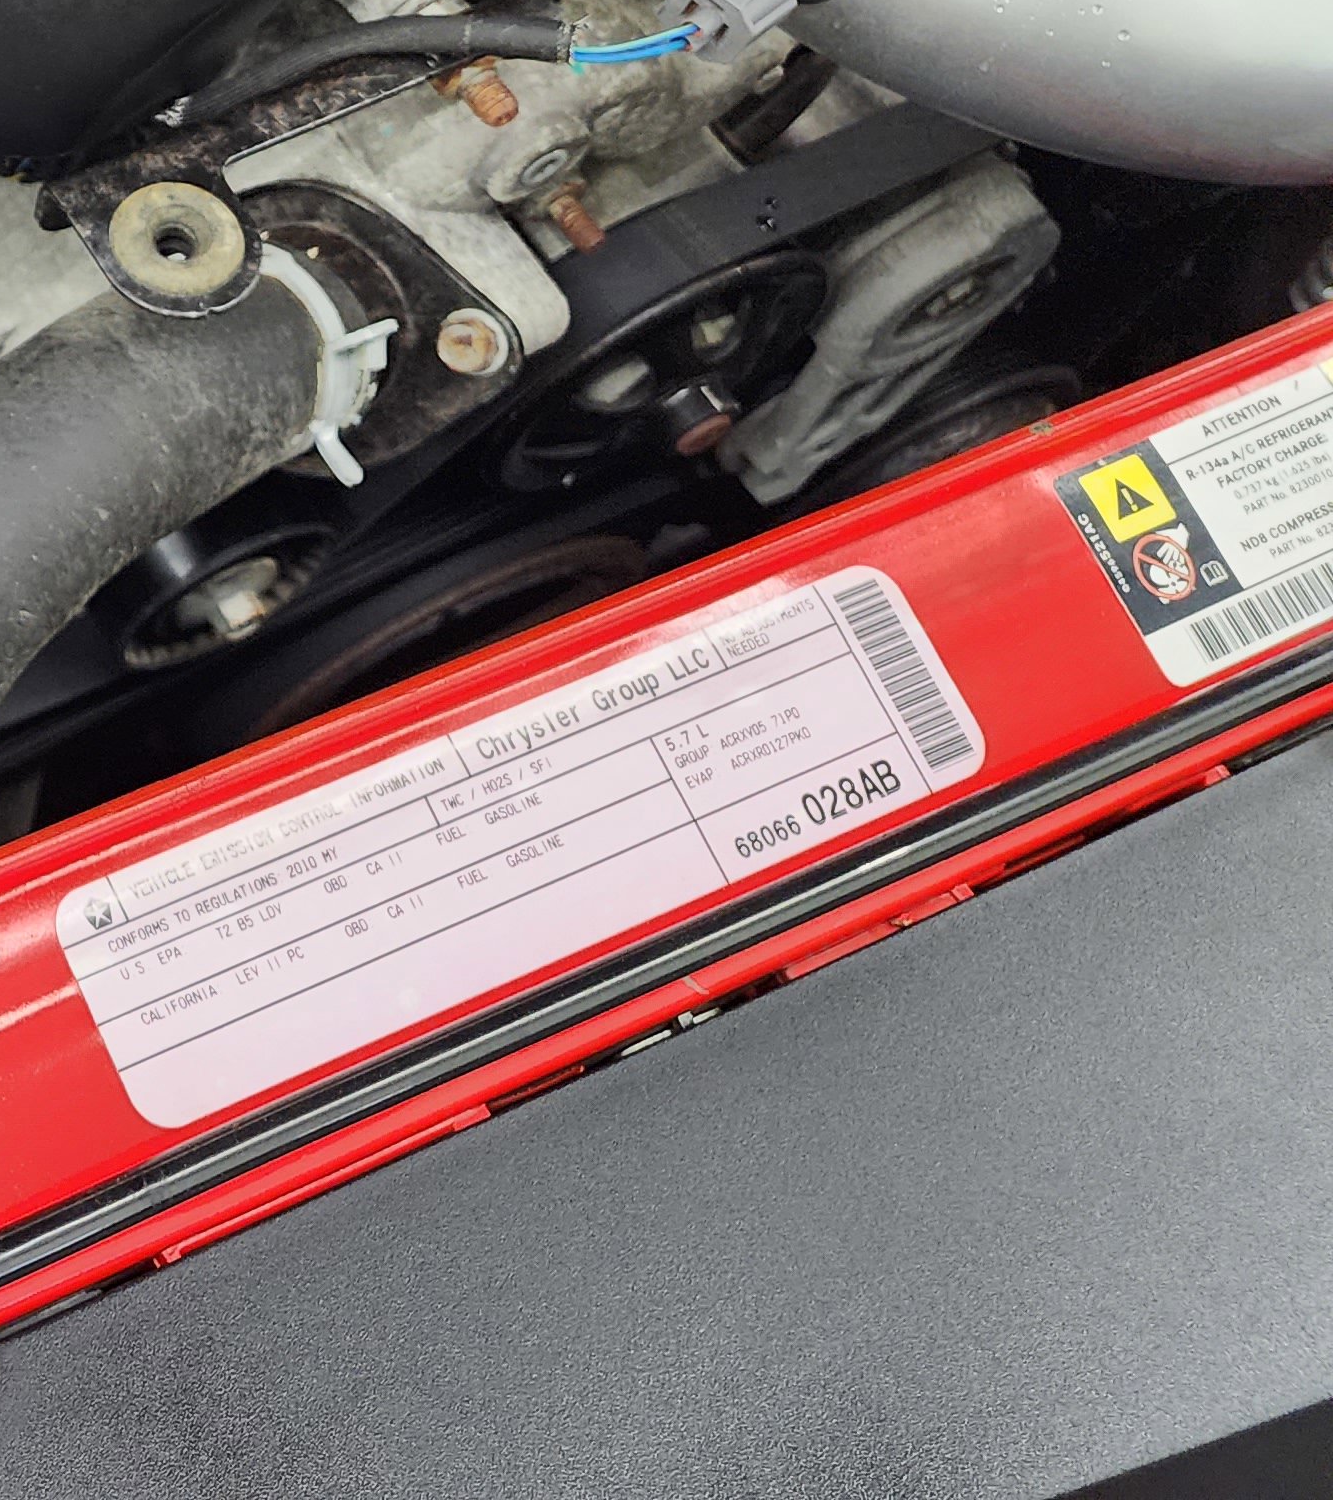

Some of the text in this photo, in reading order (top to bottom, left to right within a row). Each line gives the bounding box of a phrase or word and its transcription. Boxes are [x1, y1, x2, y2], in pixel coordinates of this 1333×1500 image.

[1201, 394, 1281, 437] ATTENTION
[1185, 456, 1229, 480] R-134a
[1231, 443, 1255, 462] A/C
[1217, 456, 1272, 488] FACTORY
[1243, 496, 1269, 514] PART
[1269, 540, 1295, 558] PART
[726, 632, 769, 658] NEEDED
[476, 647, 710, 761] Chrysler Group LLC
[665, 722, 709, 752] 5.7 L
[351, 757, 445, 808] INFORMATION
[441, 793, 465, 812] TWC
[733, 758, 901, 859] 68066 028AB
[215, 924, 233, 940] T2
[237, 914, 253, 931] B5
[258, 902, 282, 922] LDV
[365, 860, 383, 876] CA
[484, 792, 543, 825] GASOLINE
[107, 918, 169, 952] CONFORMS
[173, 908, 191, 924] TO
[285, 856, 317, 878] 2010
[321, 846, 337, 862] MY
[235, 965, 259, 985] LEV
[287, 946, 305, 962] PC
[387, 903, 405, 918] CA
[505, 834, 565, 868] GASOLINE
